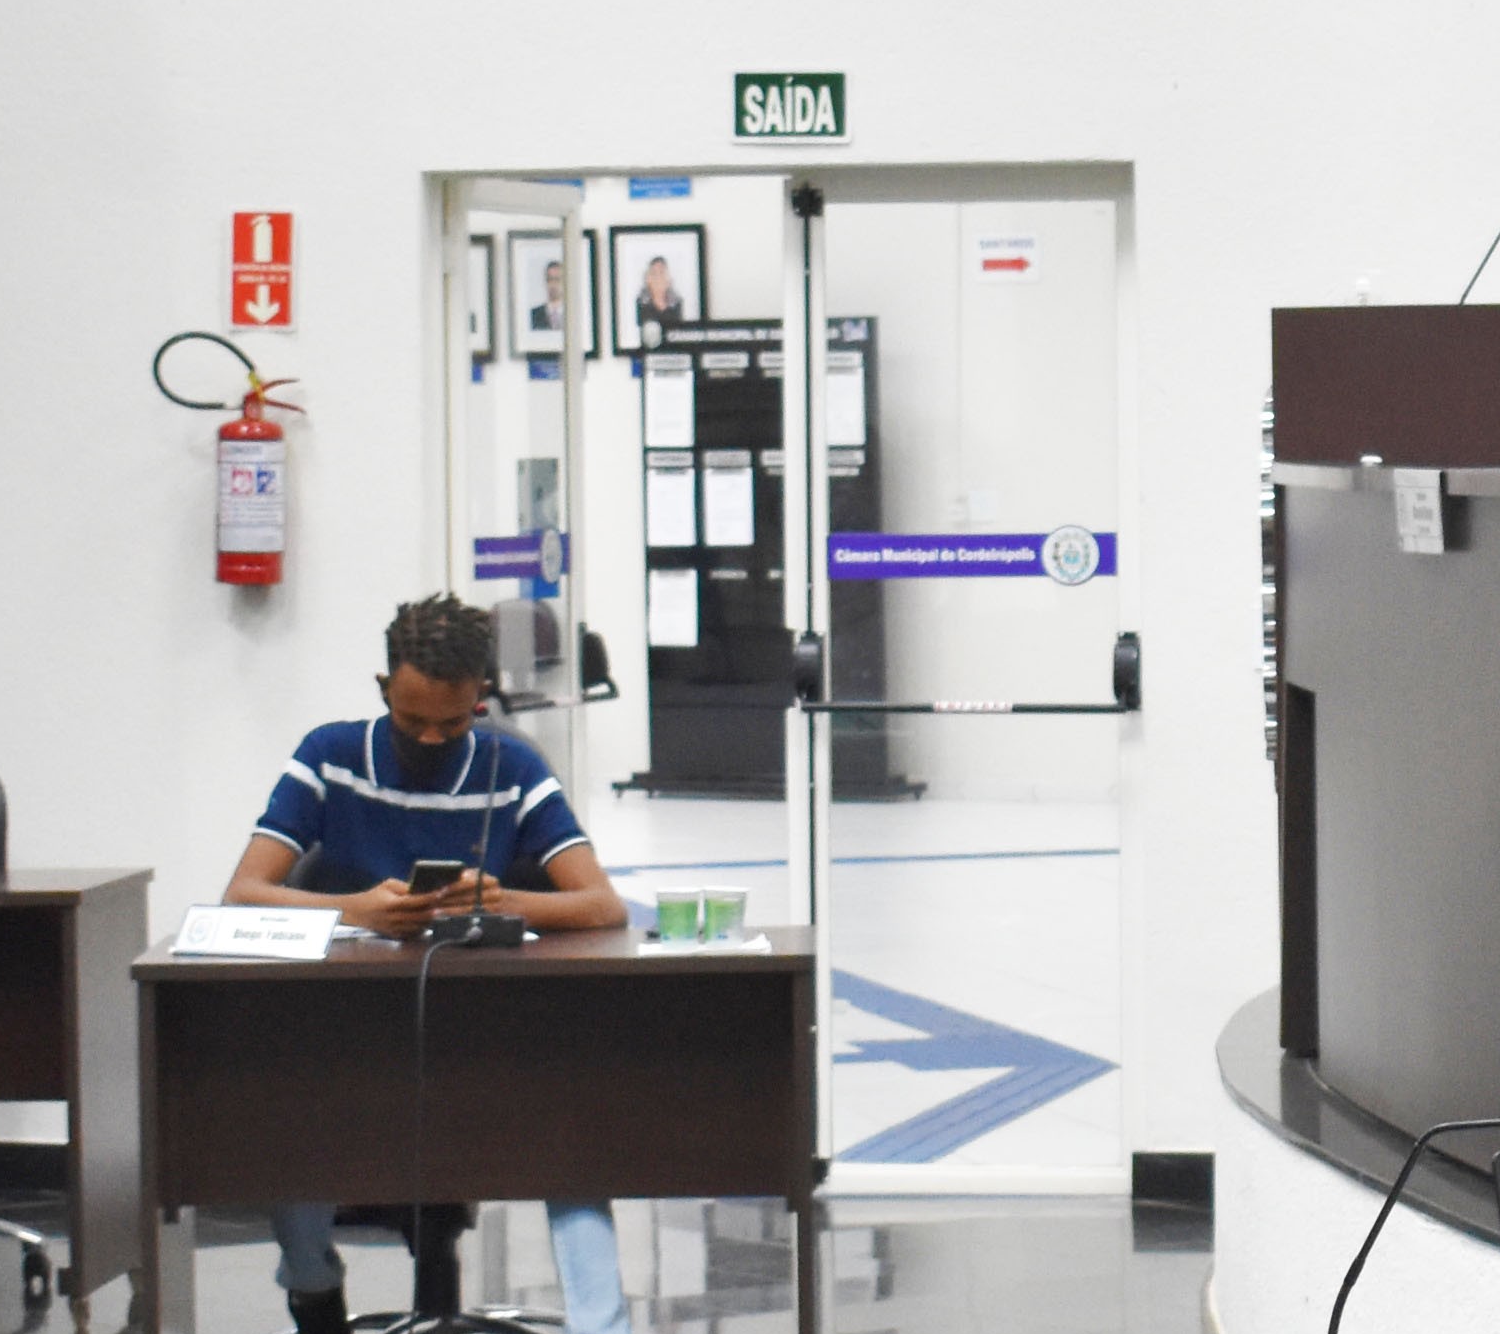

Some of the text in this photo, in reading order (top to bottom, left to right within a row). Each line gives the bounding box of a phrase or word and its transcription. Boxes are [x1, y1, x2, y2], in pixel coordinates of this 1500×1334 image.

[743, 76, 837, 134] SAÍDA
[834, 546, 1037, 564] Câmara Municipal de Cordeirópolis
